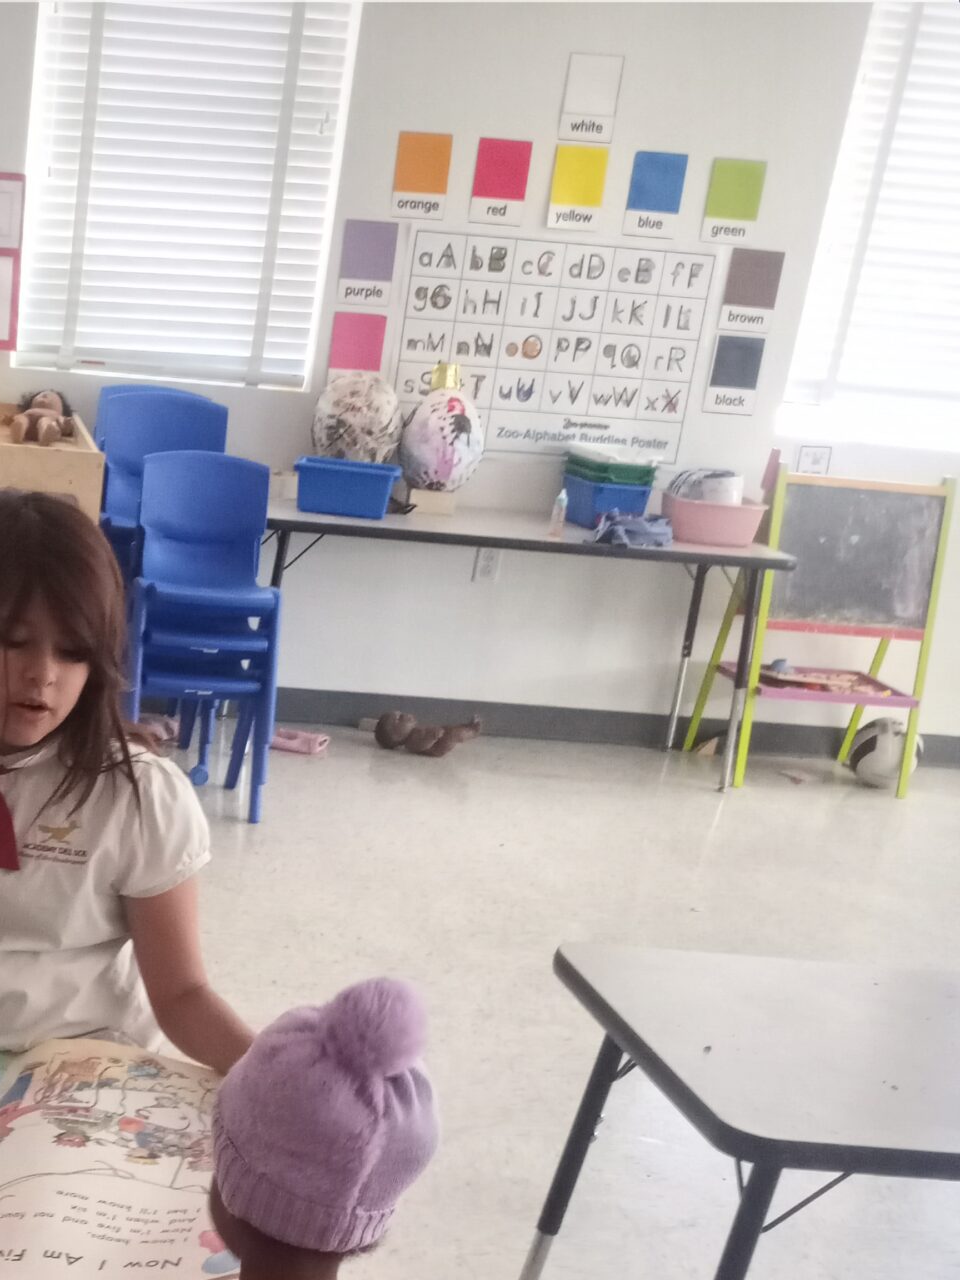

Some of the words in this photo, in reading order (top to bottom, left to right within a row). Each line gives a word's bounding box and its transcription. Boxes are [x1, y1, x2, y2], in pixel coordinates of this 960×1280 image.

[570, 119, 604, 135] white
[397, 199, 440, 214] orange
[486, 204, 508, 217] red
[555, 208, 593, 224] yellow
[637, 215, 664, 230] blue
[710, 224, 746, 238] green
[344, 285, 383, 299] purple
[727, 310, 765, 325] brown
[714, 393, 745, 407] black
[496, 426, 577, 444] Zoo-Alphabet
[579, 432, 628, 447] Buddies
[630, 436, 670, 451] Poster
[42, 1249, 84, 1266] Am
[98, 1259, 108, 1271] I
[122, 1256, 183, 1270] Now
